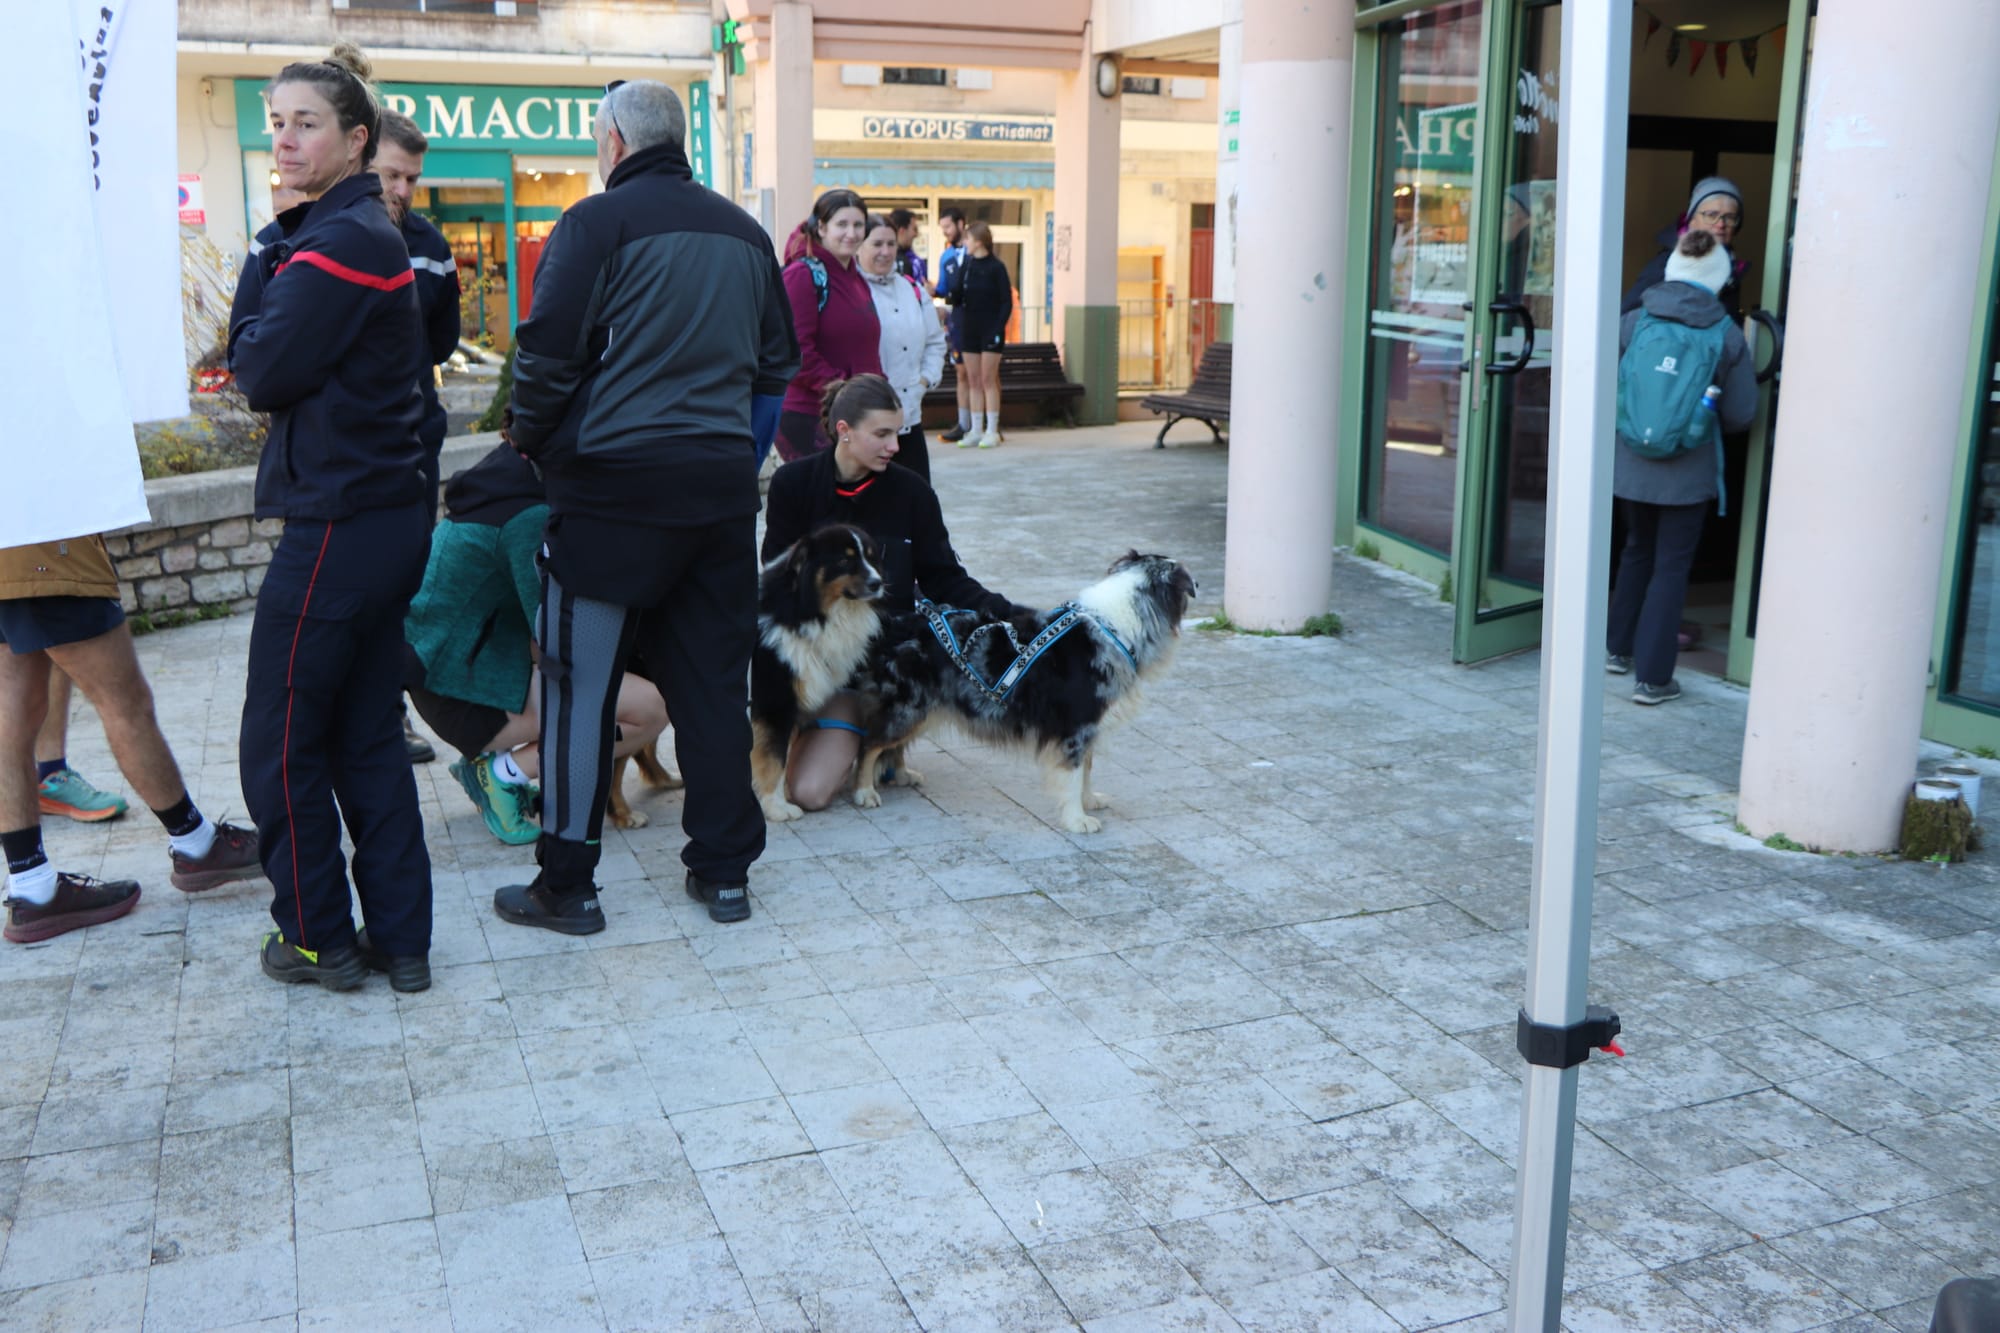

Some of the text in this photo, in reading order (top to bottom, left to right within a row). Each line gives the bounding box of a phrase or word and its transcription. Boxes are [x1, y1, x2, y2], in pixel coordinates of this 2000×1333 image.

[259, 92, 602, 140] RMACIE
[693, 87, 705, 185] PHAR
[865, 117, 1050, 140] OCTOPUS artisanat
